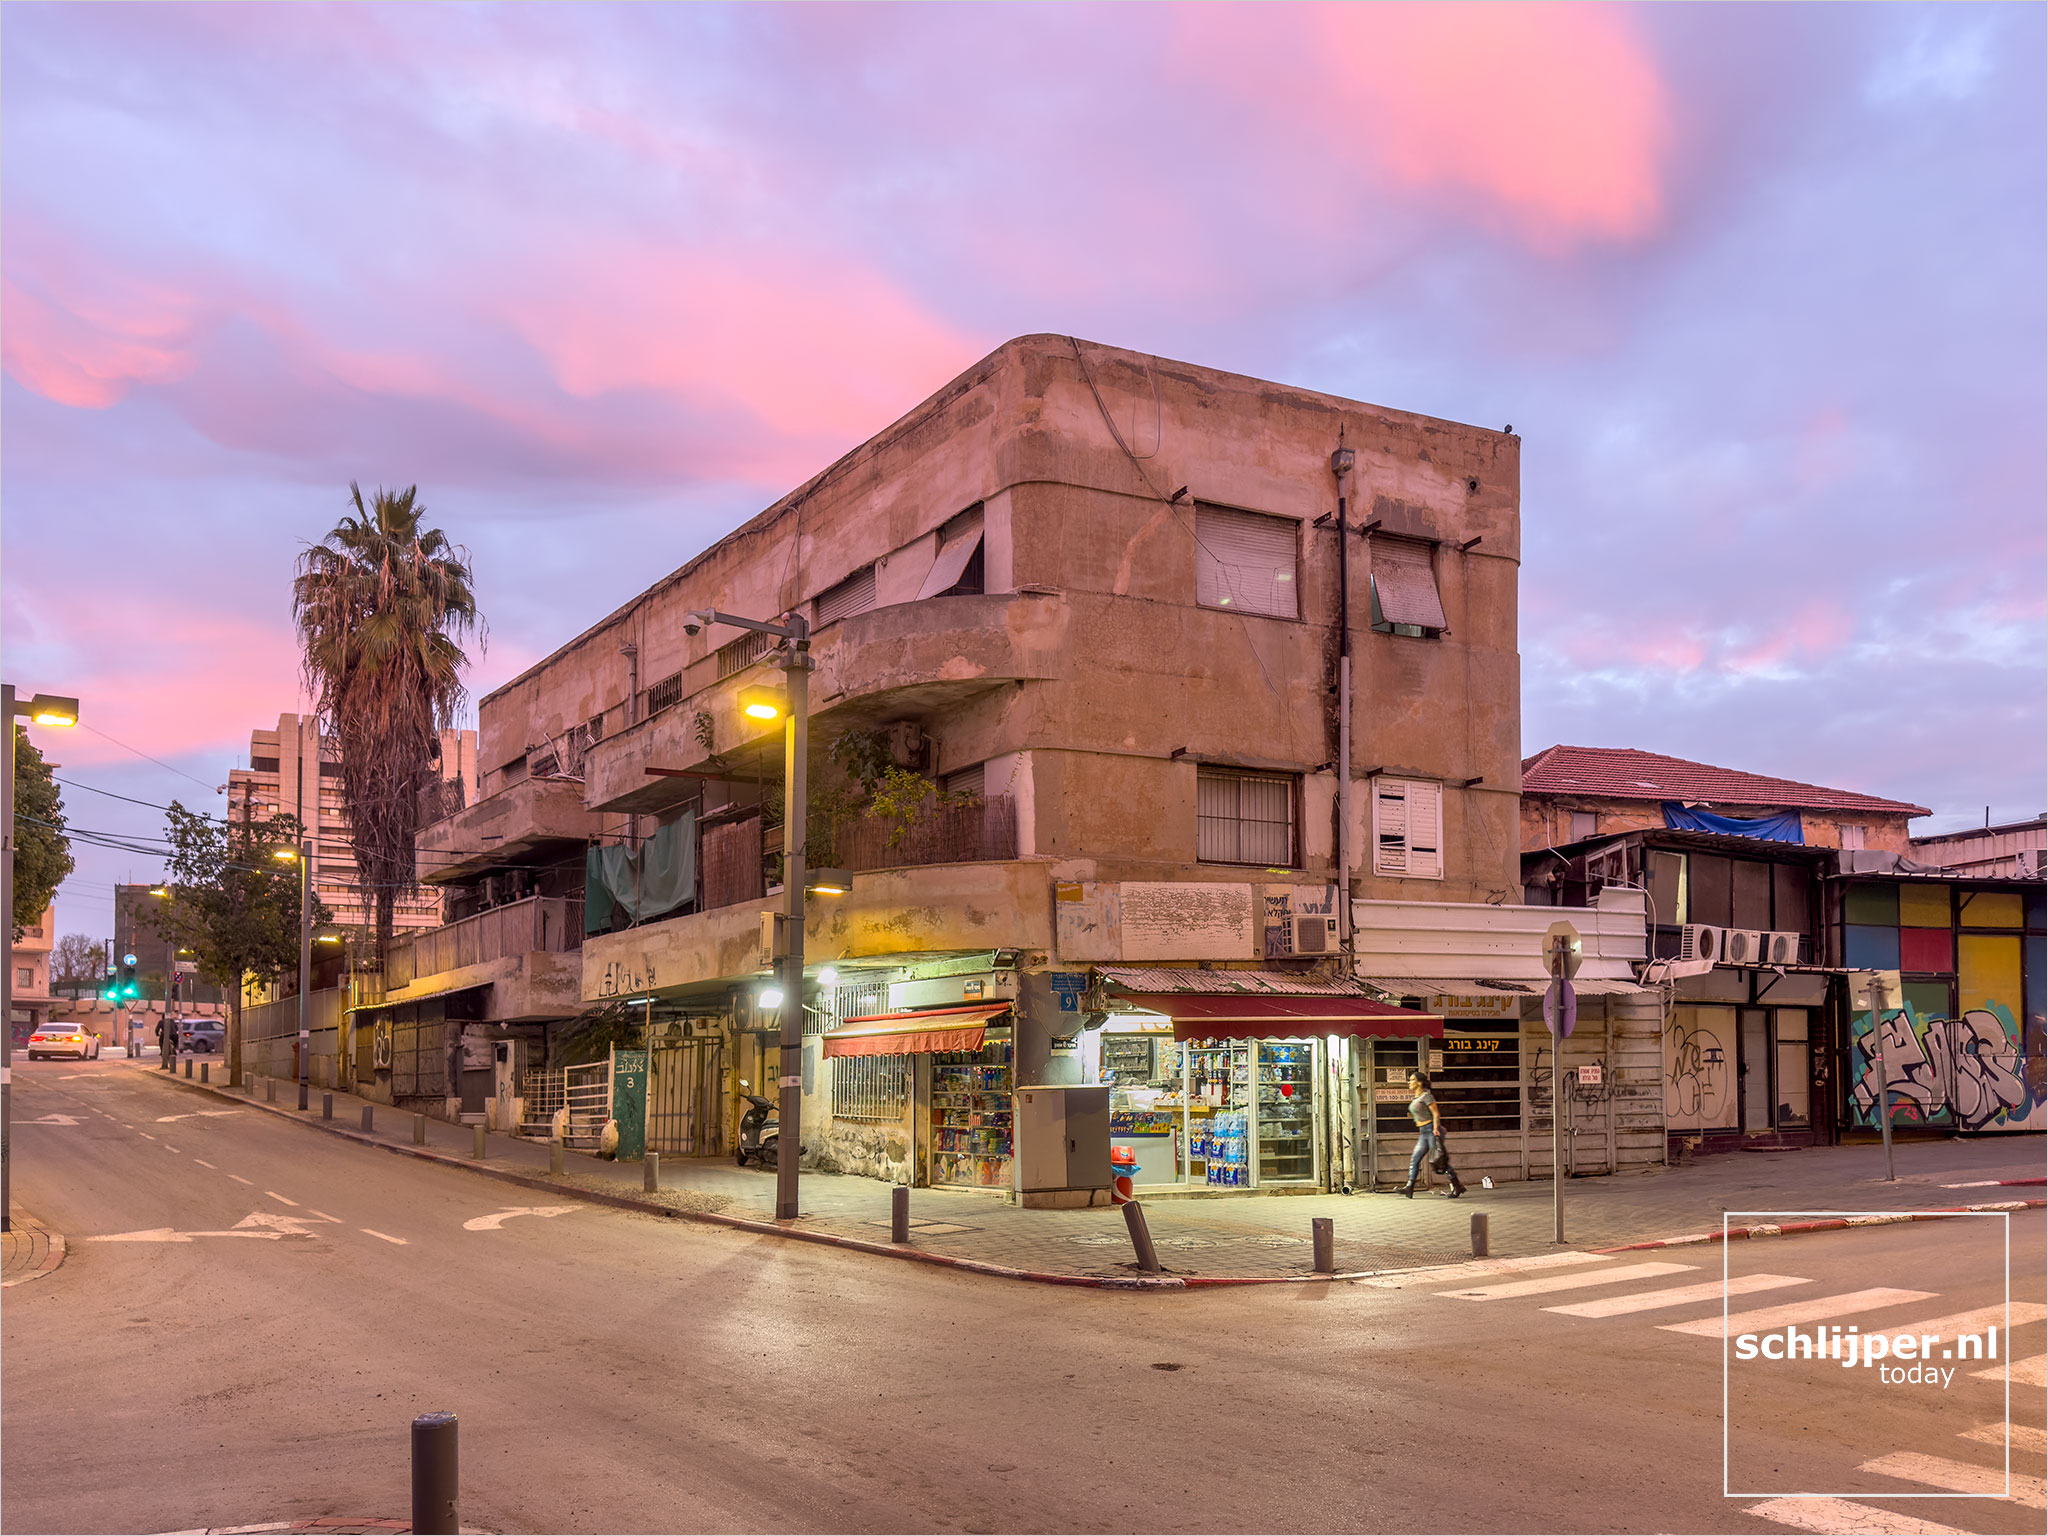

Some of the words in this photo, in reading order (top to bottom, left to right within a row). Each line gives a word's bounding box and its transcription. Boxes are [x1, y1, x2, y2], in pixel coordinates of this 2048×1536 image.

[1065, 996, 1072, 1009] 9
[1448, 1040, 1472, 1050] בורג
[1476, 1040, 1500, 1052] קינג
[626, 1076, 635, 1089] 3
